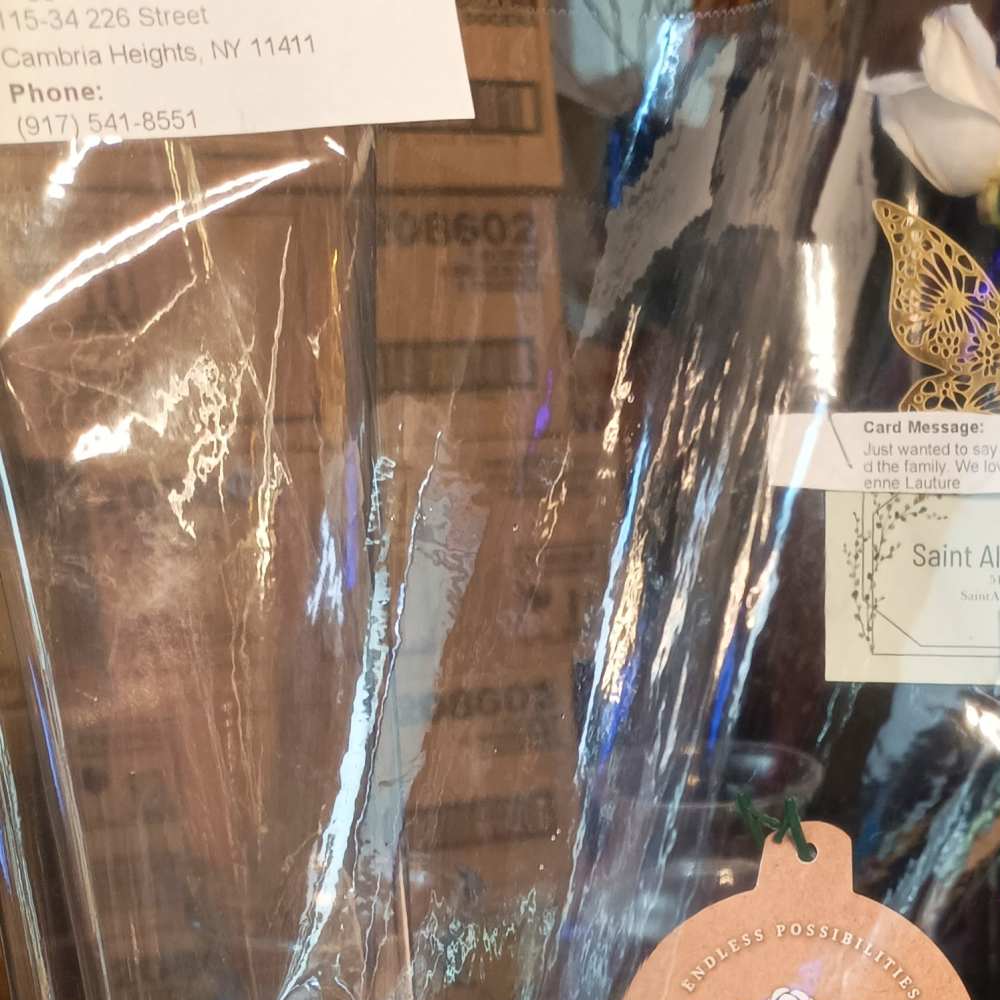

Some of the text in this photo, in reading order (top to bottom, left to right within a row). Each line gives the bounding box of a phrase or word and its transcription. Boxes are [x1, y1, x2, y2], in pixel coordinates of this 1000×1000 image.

[86, 8, 130, 29] 226
[138, 6, 209, 28] Street
[1, 35, 314, 69] Cambria Heights, NY 11411
[8, 82, 103, 104] Phone:
[17, 109, 197, 141] (917) 541-8551
[863, 420, 984, 437] Card Message:
[863, 442, 893, 456] Just
[897, 443, 950, 457] wanted
[955, 443, 968, 456] to
[973, 446, 997, 460] say
[863, 461, 873, 473] d
[876, 459, 899, 472] the
[956, 459, 979, 472] We
[864, 476, 961, 490] enne Lauture
[912, 543, 973, 568] Saint
[681, 923, 922, 1000] ENDLESS POSSIBILITIES
